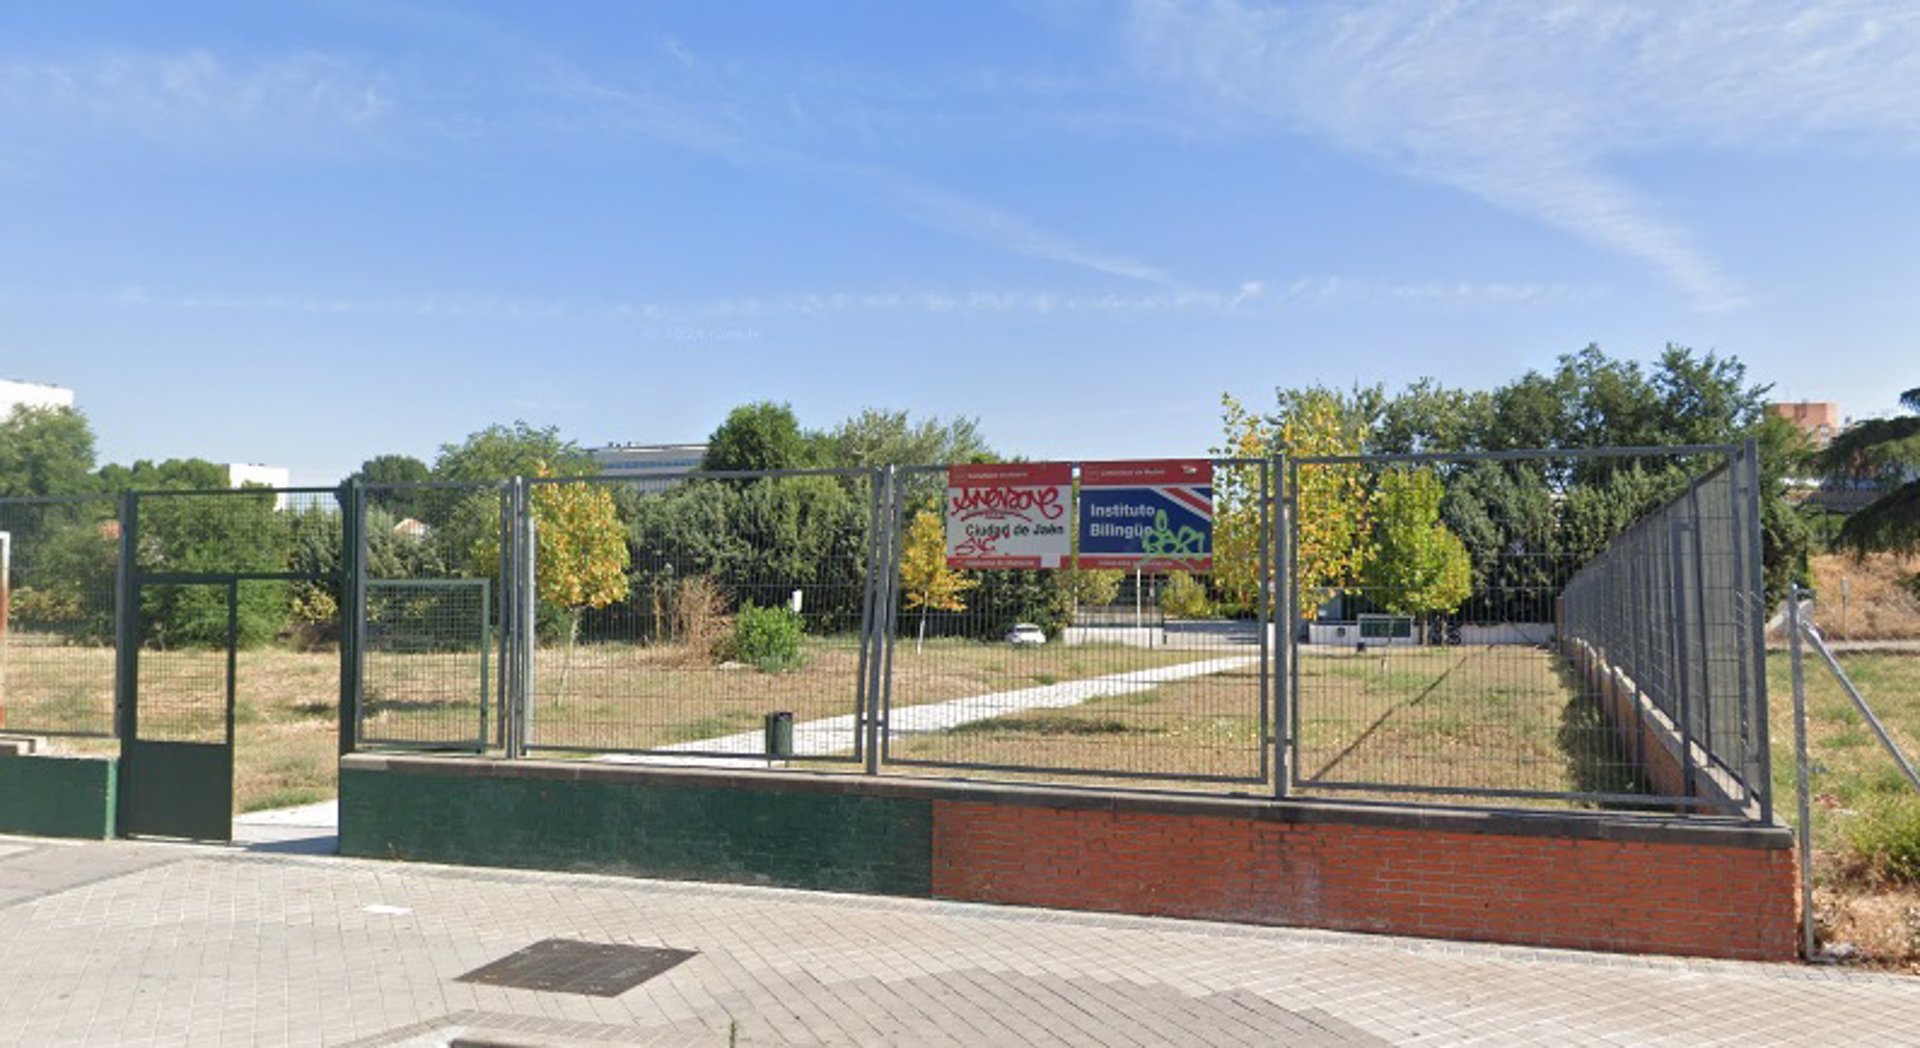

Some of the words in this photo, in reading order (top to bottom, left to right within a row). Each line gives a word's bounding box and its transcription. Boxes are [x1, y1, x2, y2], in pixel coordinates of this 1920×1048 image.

[1090, 503, 1155, 518] Instituto
[965, 523, 1010, 537] Ciudad
[1013, 523, 1030, 536] de
